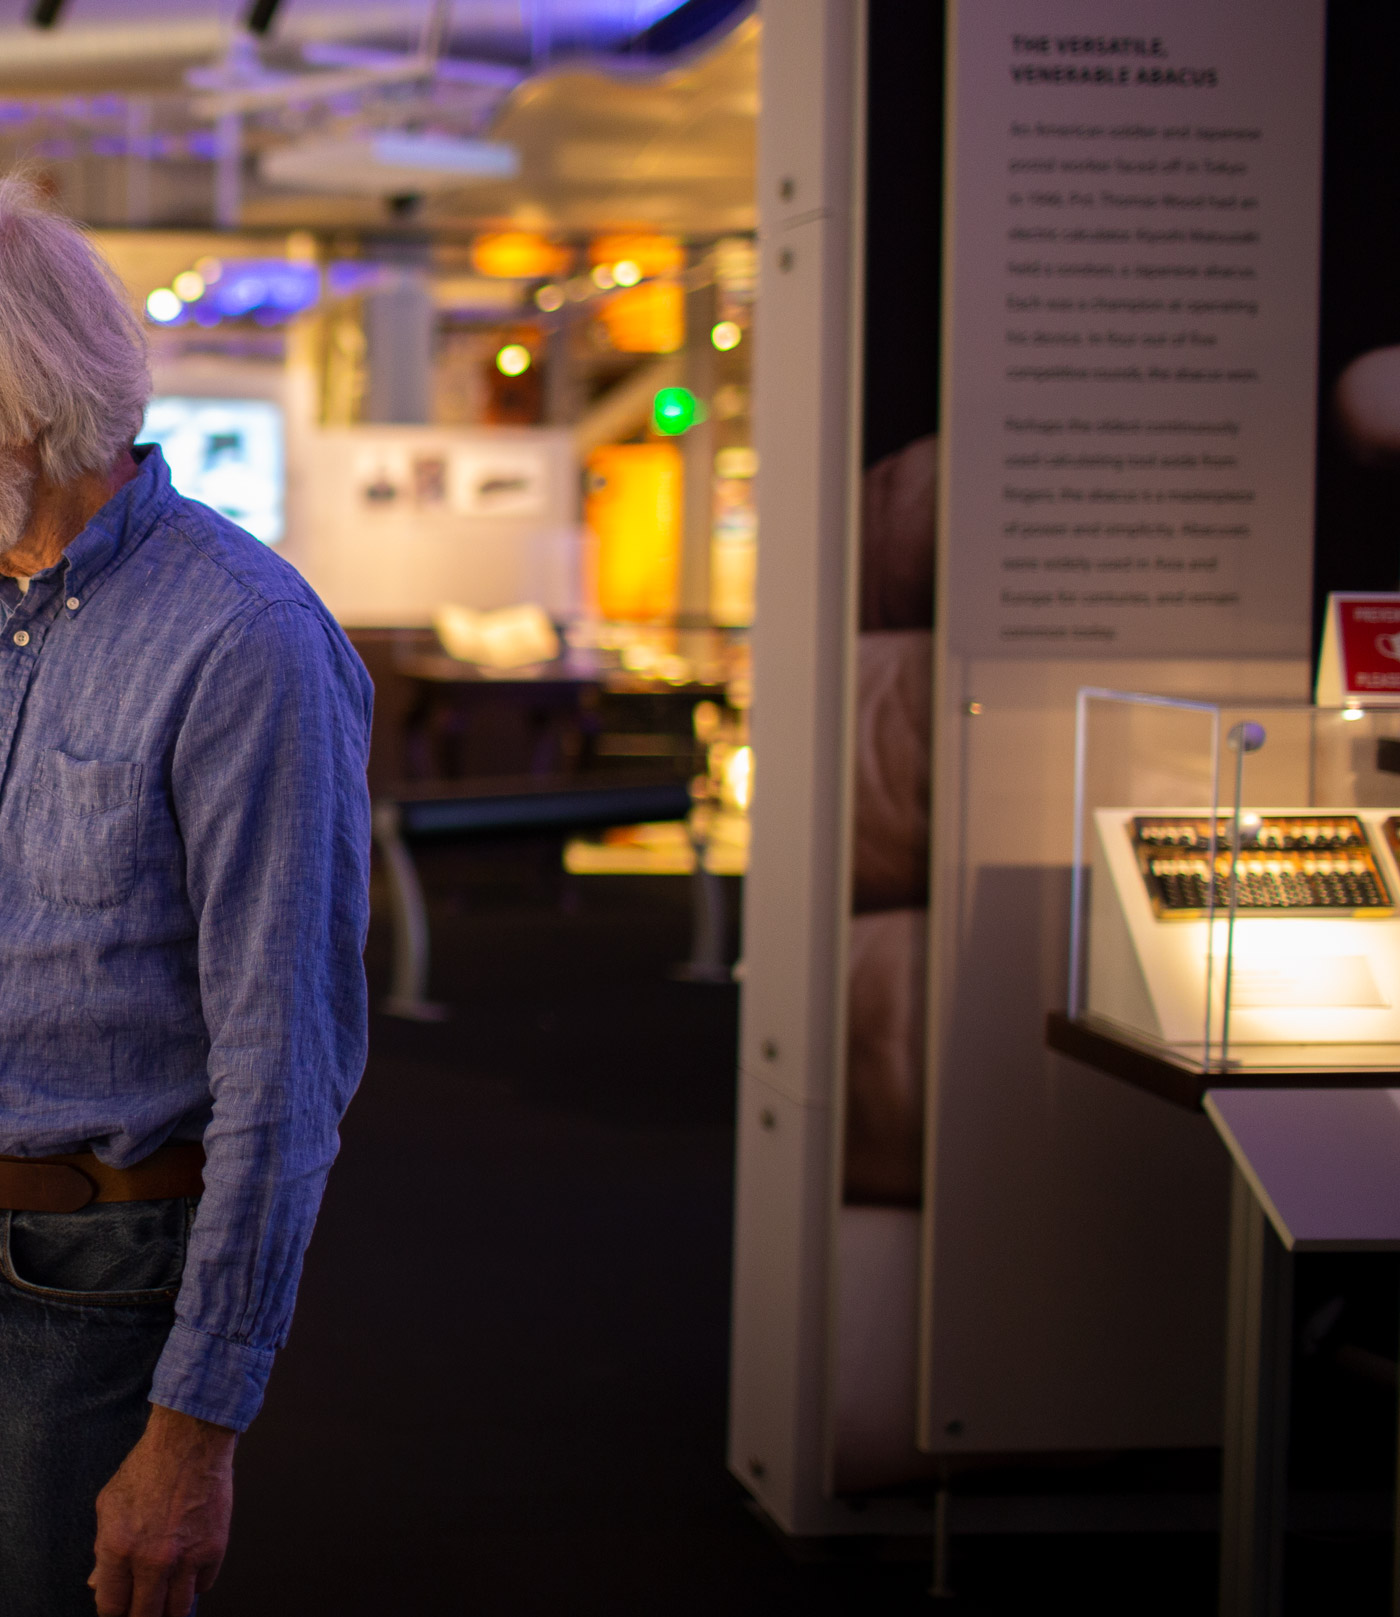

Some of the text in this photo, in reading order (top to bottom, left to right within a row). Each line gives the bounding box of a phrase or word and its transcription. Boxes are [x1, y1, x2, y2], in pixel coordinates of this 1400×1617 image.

[1011, 35, 1168, 57] THE VERSATILE,
[1010, 67, 1218, 87] VENERABLE ABACUS
